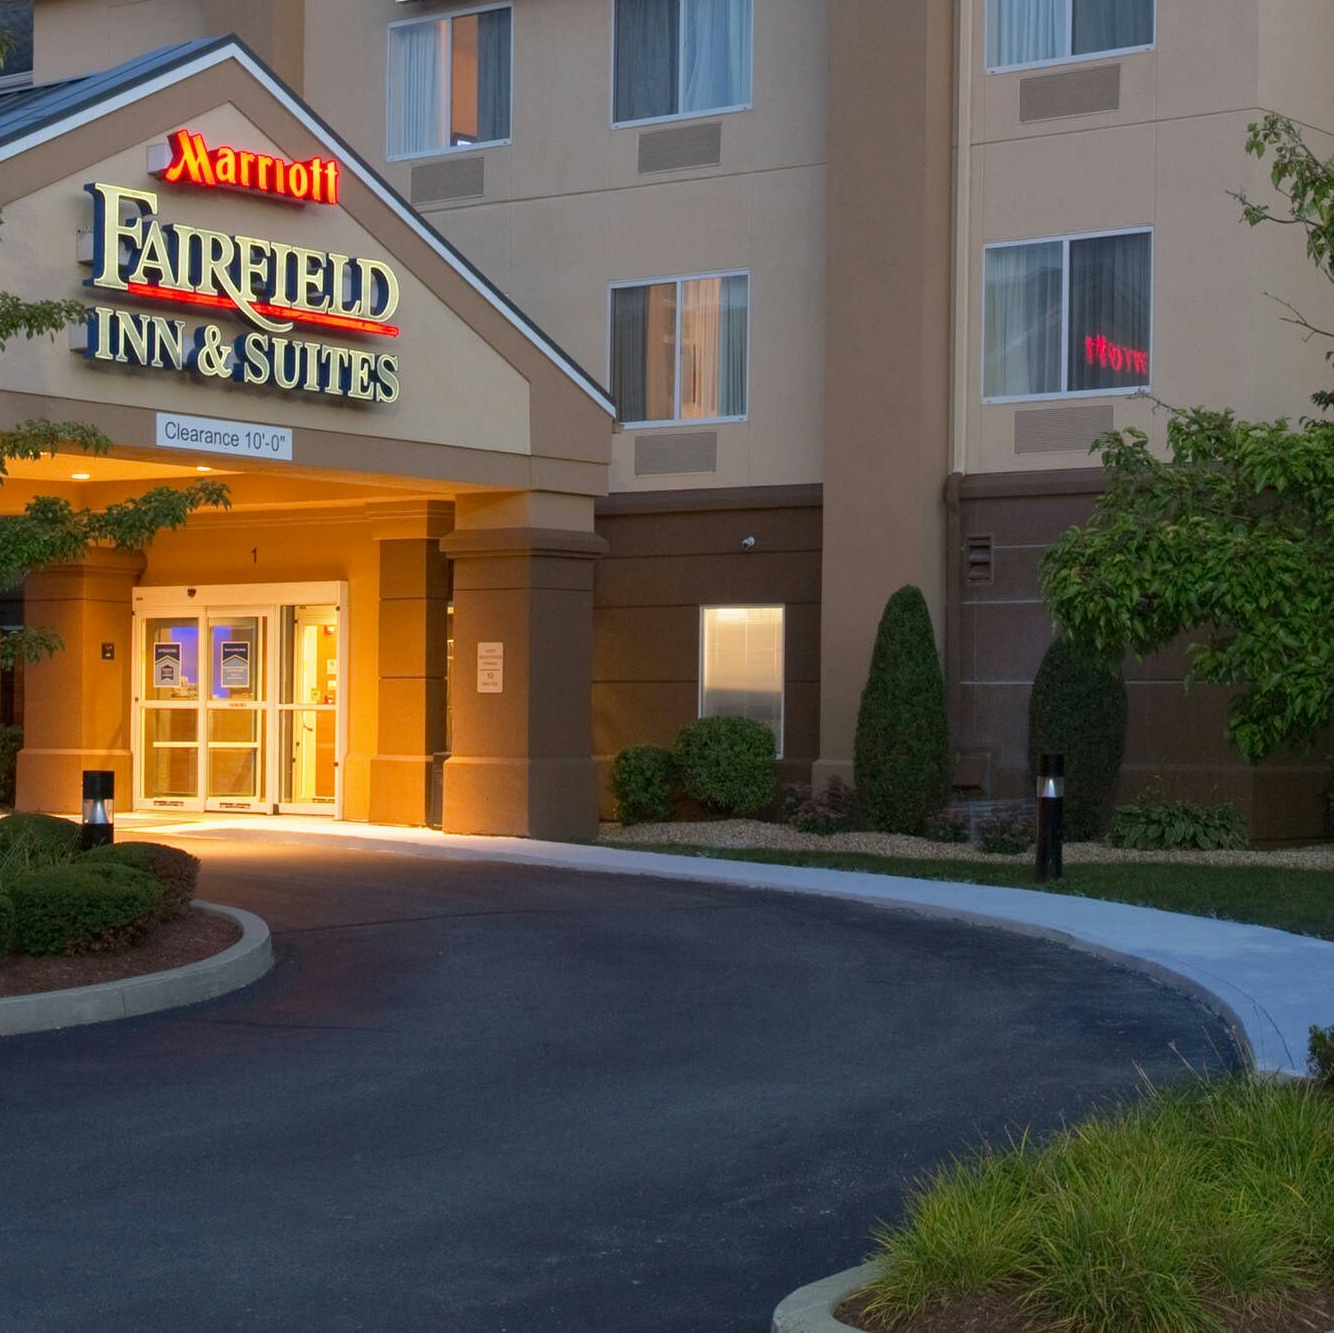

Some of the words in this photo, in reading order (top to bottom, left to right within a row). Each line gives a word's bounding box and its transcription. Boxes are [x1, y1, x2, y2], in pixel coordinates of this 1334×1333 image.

[166, 129, 340, 204] Marriott
[93, 182, 400, 333] FAIRFIELD
[94, 307, 186, 371] INN
[197, 324, 233, 378] &
[243, 331, 401, 404] SUITES
[164, 421, 240, 447] Clearance
[244, 430, 286, 452] 10'-0"
